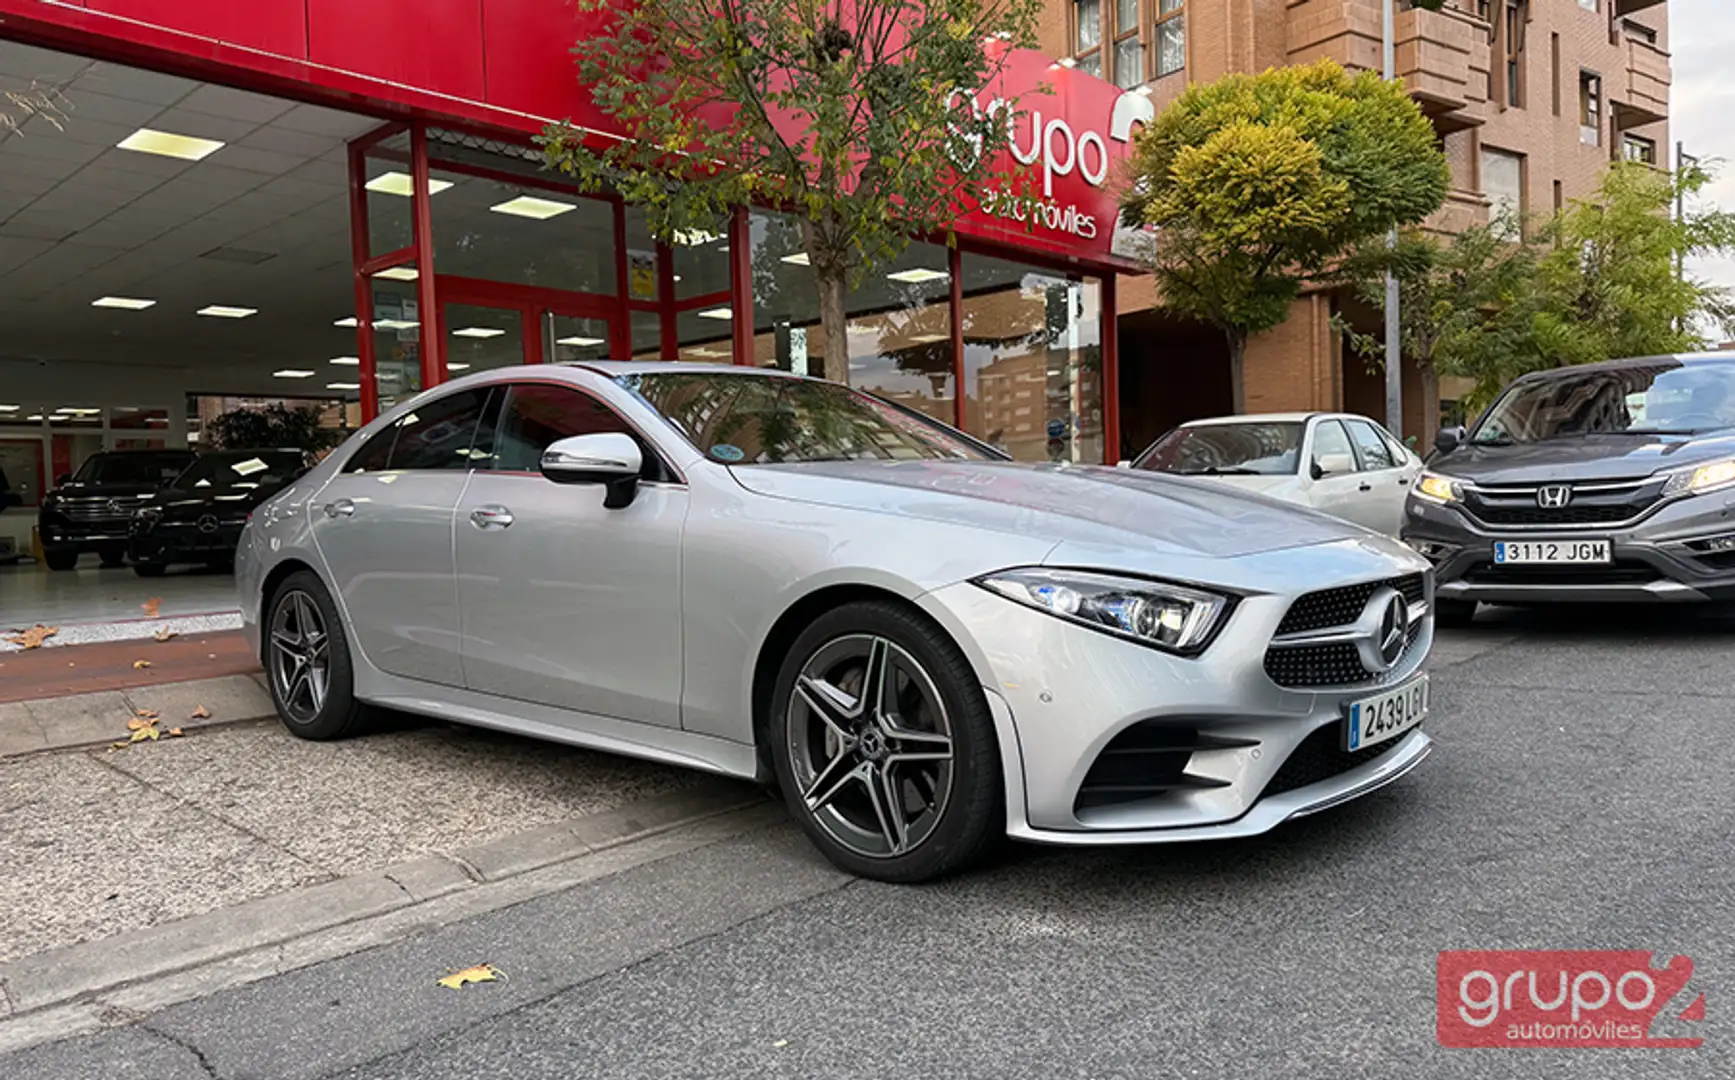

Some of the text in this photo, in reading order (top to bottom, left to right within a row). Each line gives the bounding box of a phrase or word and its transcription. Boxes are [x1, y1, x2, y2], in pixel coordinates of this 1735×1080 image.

[1508, 543, 1605, 560] 3112 JGM
[1365, 694, 1405, 738] 2439
